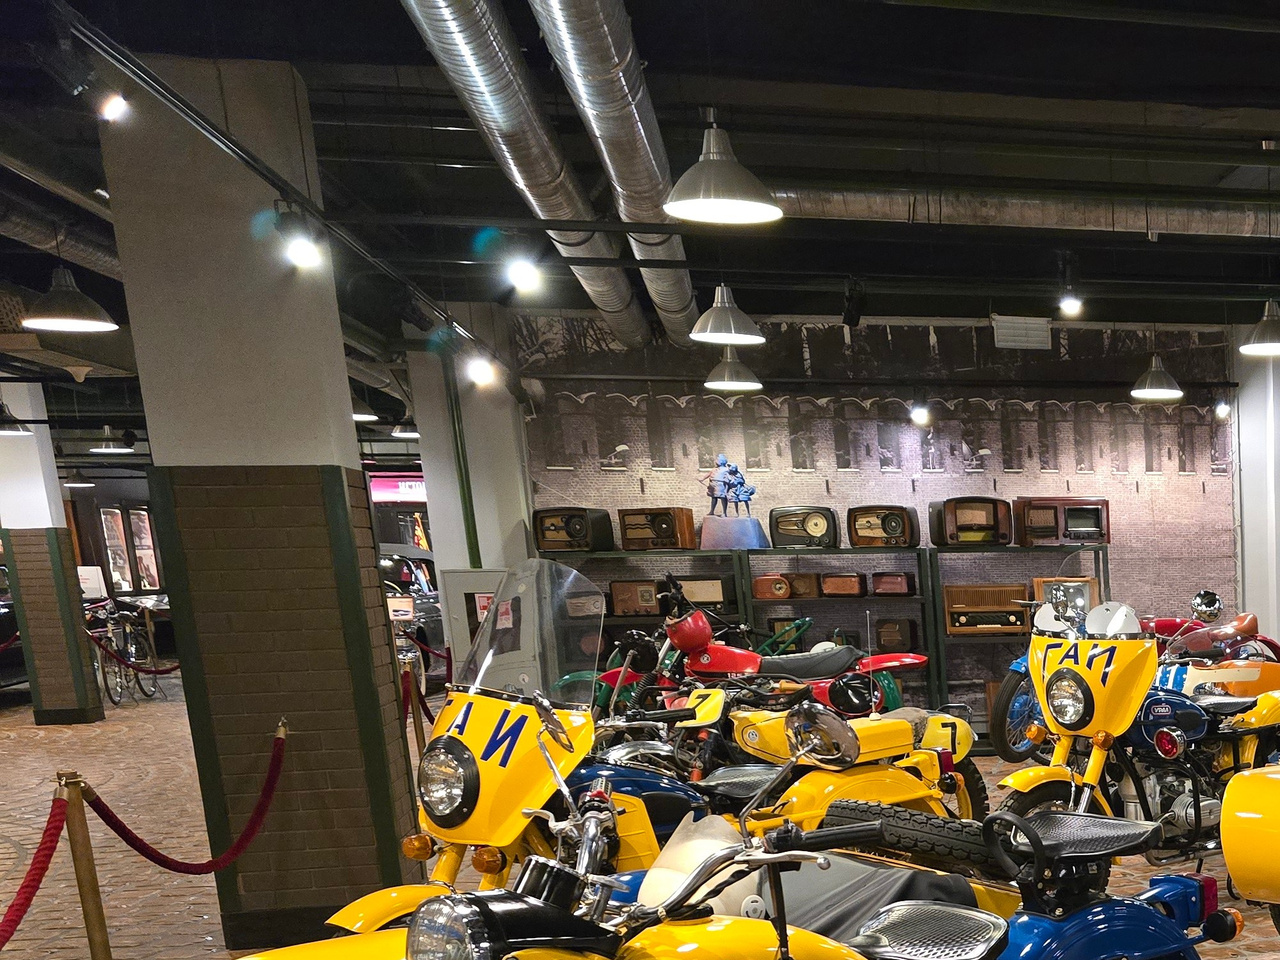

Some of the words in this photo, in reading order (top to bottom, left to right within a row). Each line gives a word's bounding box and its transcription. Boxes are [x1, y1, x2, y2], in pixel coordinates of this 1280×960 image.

[1042, 642, 1118, 688] ГАИ
[694, 693, 713, 709] 7
[446, 699, 529, 768] АИ
[941, 722, 957, 755] 7
